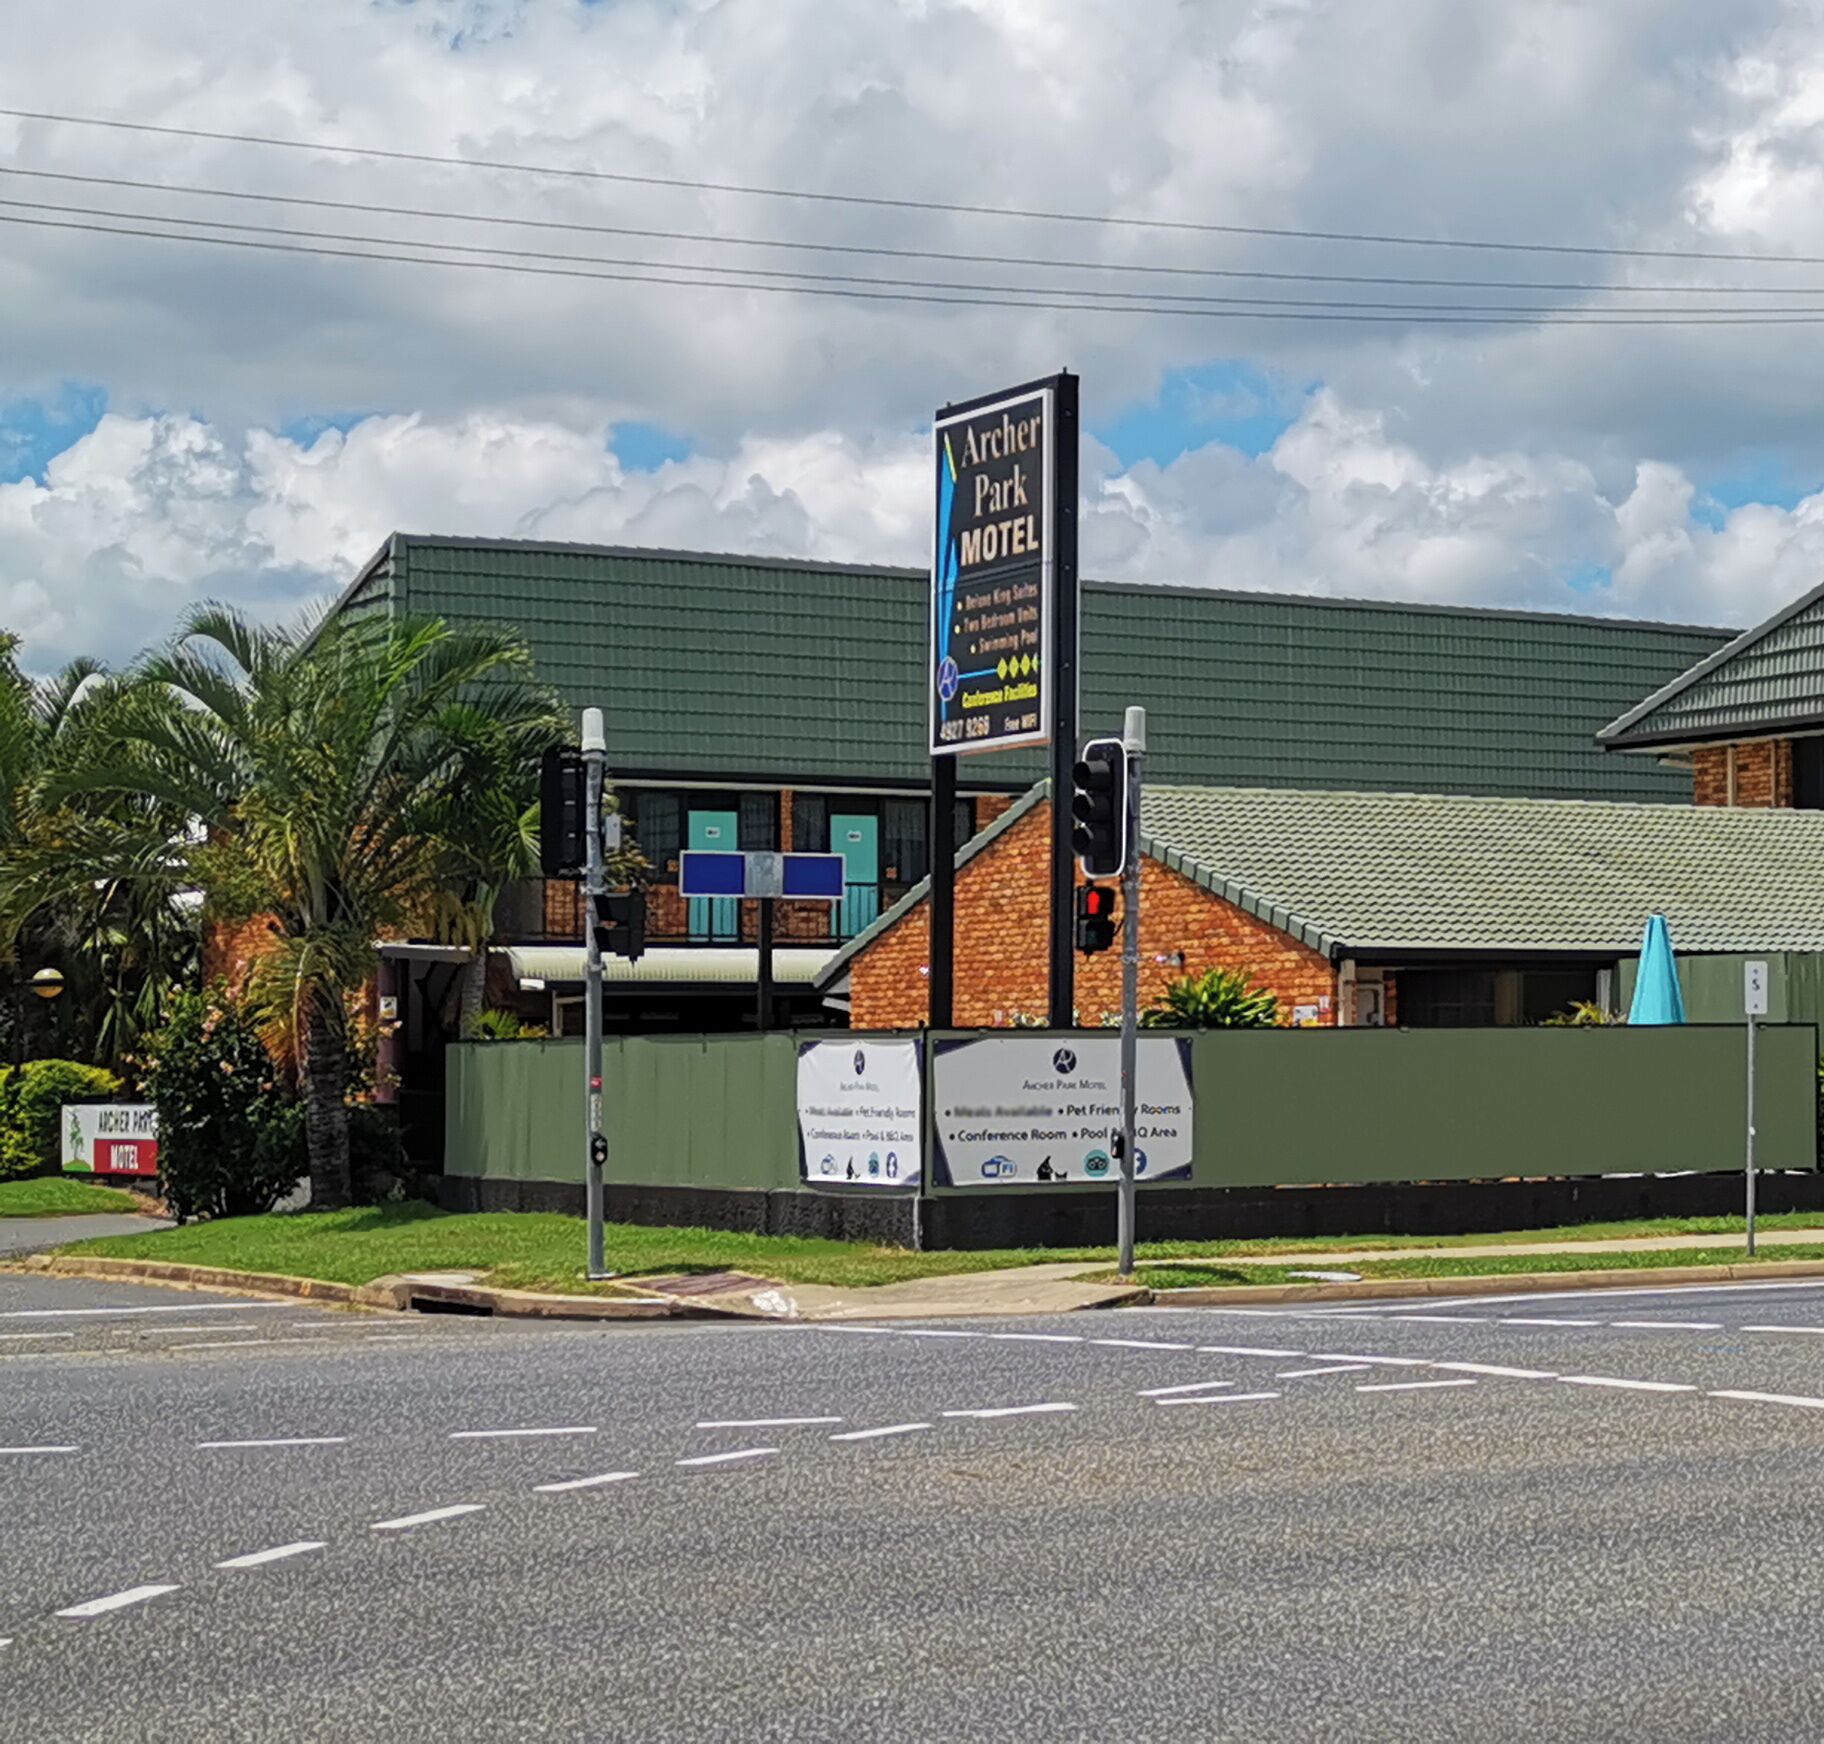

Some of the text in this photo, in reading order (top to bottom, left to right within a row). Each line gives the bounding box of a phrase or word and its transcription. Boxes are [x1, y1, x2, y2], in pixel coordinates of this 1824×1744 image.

[961, 413, 1041, 468] Archer
[973, 464, 1028, 518] Park
[961, 514, 1039, 567] MOTEL
[964, 617, 979, 632] Two
[979, 627, 1038, 654] Swimming Pool
[962, 690, 1003, 709] Conference
[98, 1110, 129, 1133] ARCHER
[1067, 1105, 1087, 1116] Pet
[1141, 1103, 1181, 1115] Rooms
[958, 1129, 1028, 1142] Conference
[1031, 1128, 1067, 1141] Room
[1081, 1127, 1107, 1139] Pool
[1151, 1127, 1178, 1138] Area
[111, 1144, 138, 1169] MOTEL
